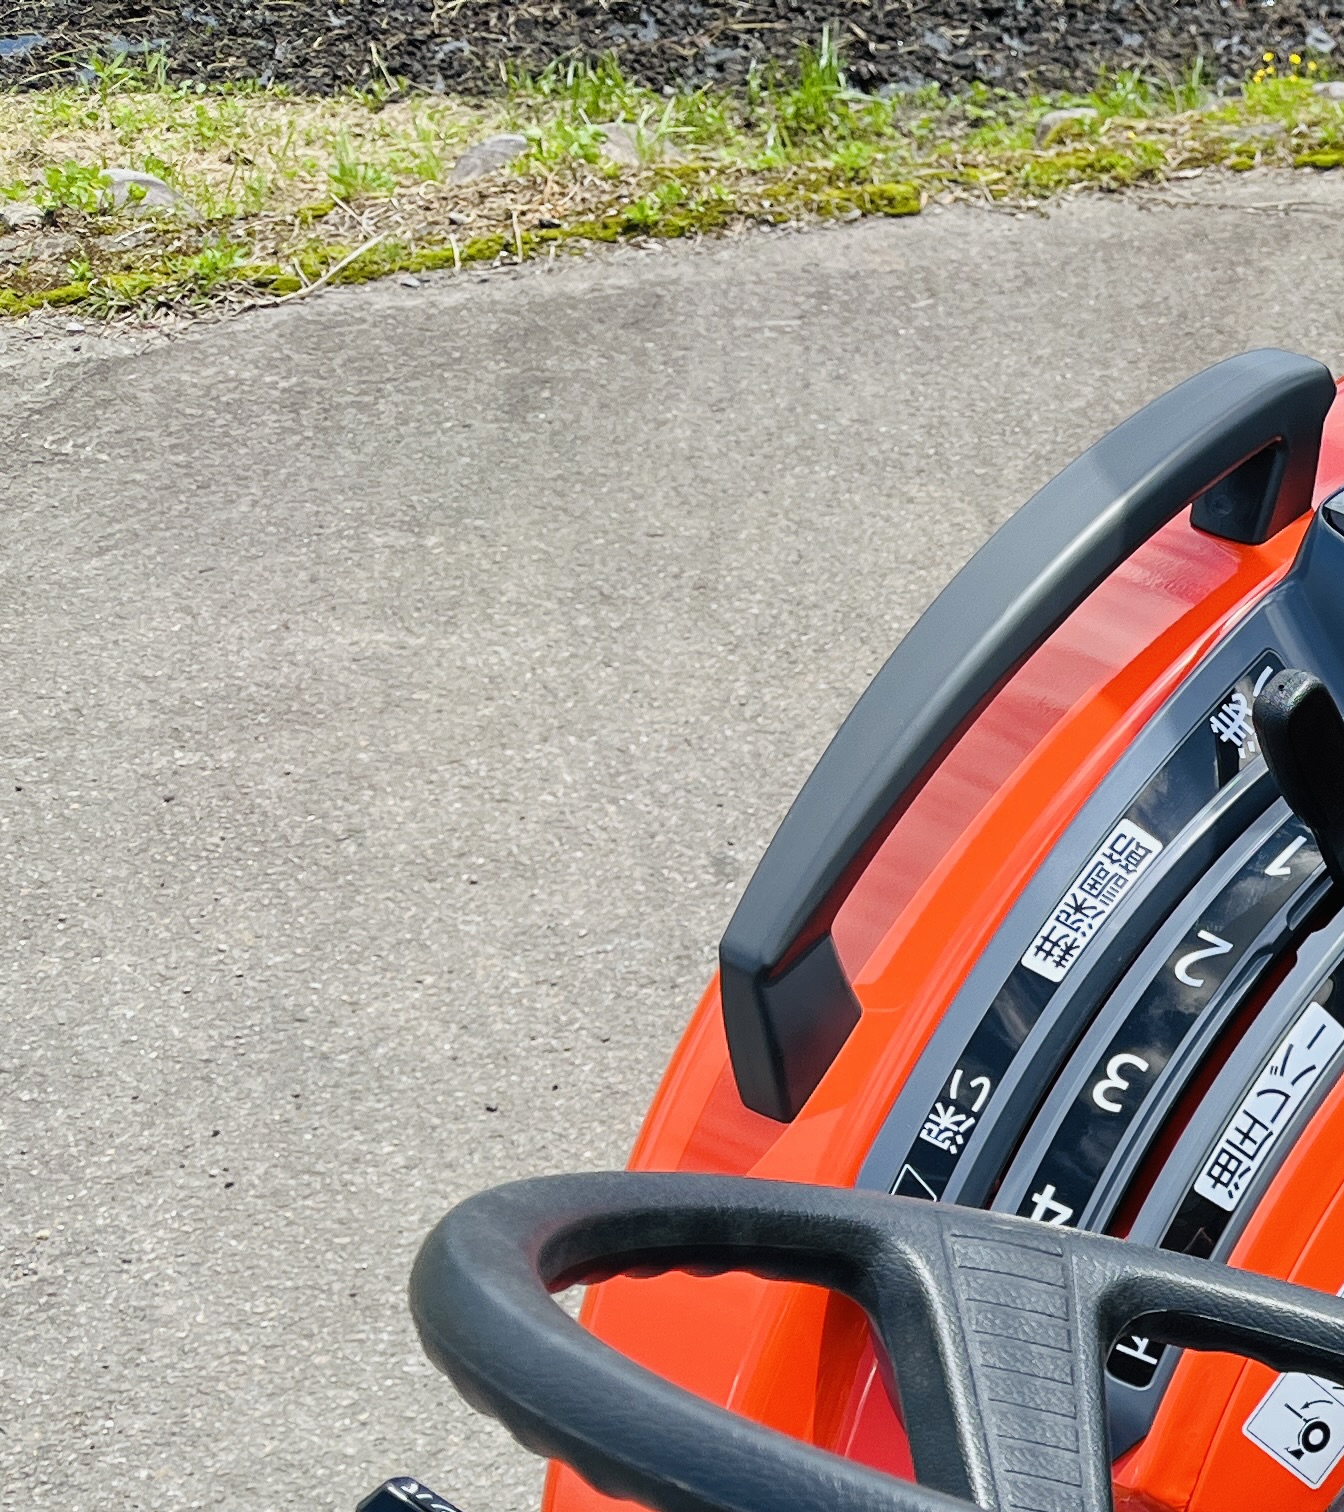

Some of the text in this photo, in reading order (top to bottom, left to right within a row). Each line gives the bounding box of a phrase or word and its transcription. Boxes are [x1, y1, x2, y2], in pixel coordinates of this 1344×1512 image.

[1264, 836, 1307, 876] 1
[1034, 830, 1156, 974] 耕深調節
[1175, 930, 1235, 990] 2
[920, 1069, 991, 1154] 深い
[1092, 1053, 1149, 1113] 3
[1205, 1022, 1331, 1199] 油圧レバー
